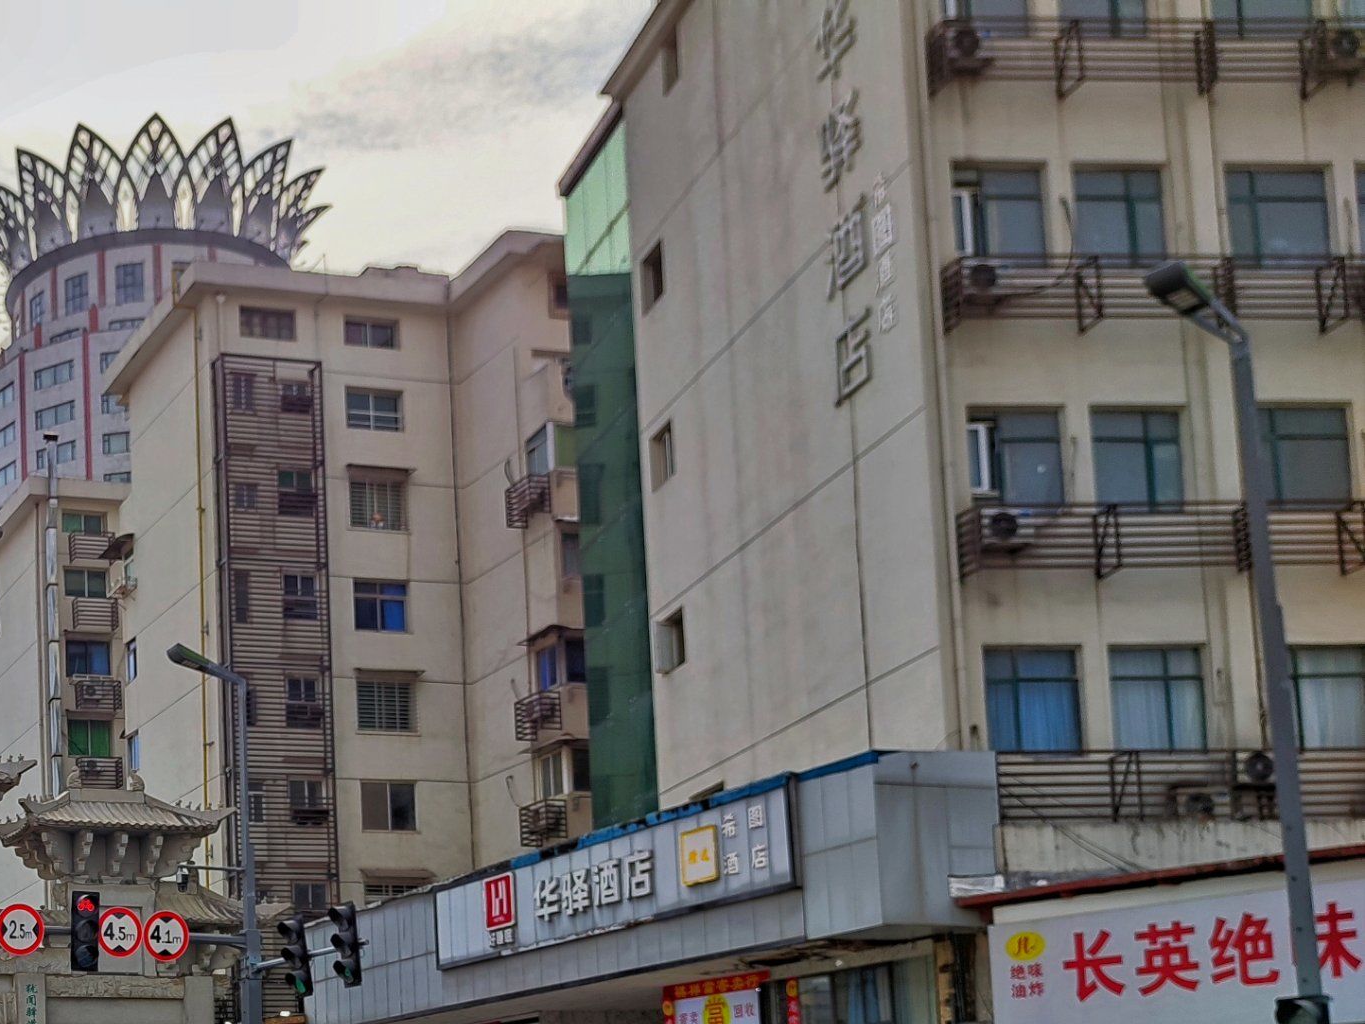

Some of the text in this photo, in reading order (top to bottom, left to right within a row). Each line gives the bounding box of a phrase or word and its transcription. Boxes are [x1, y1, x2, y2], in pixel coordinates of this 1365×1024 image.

[534, 849, 654, 922] 华驿酒店
[8, 919, 33, 940] 2.5m
[103, 921, 135, 942] 4.5m
[150, 924, 182, 944] 4.1m
